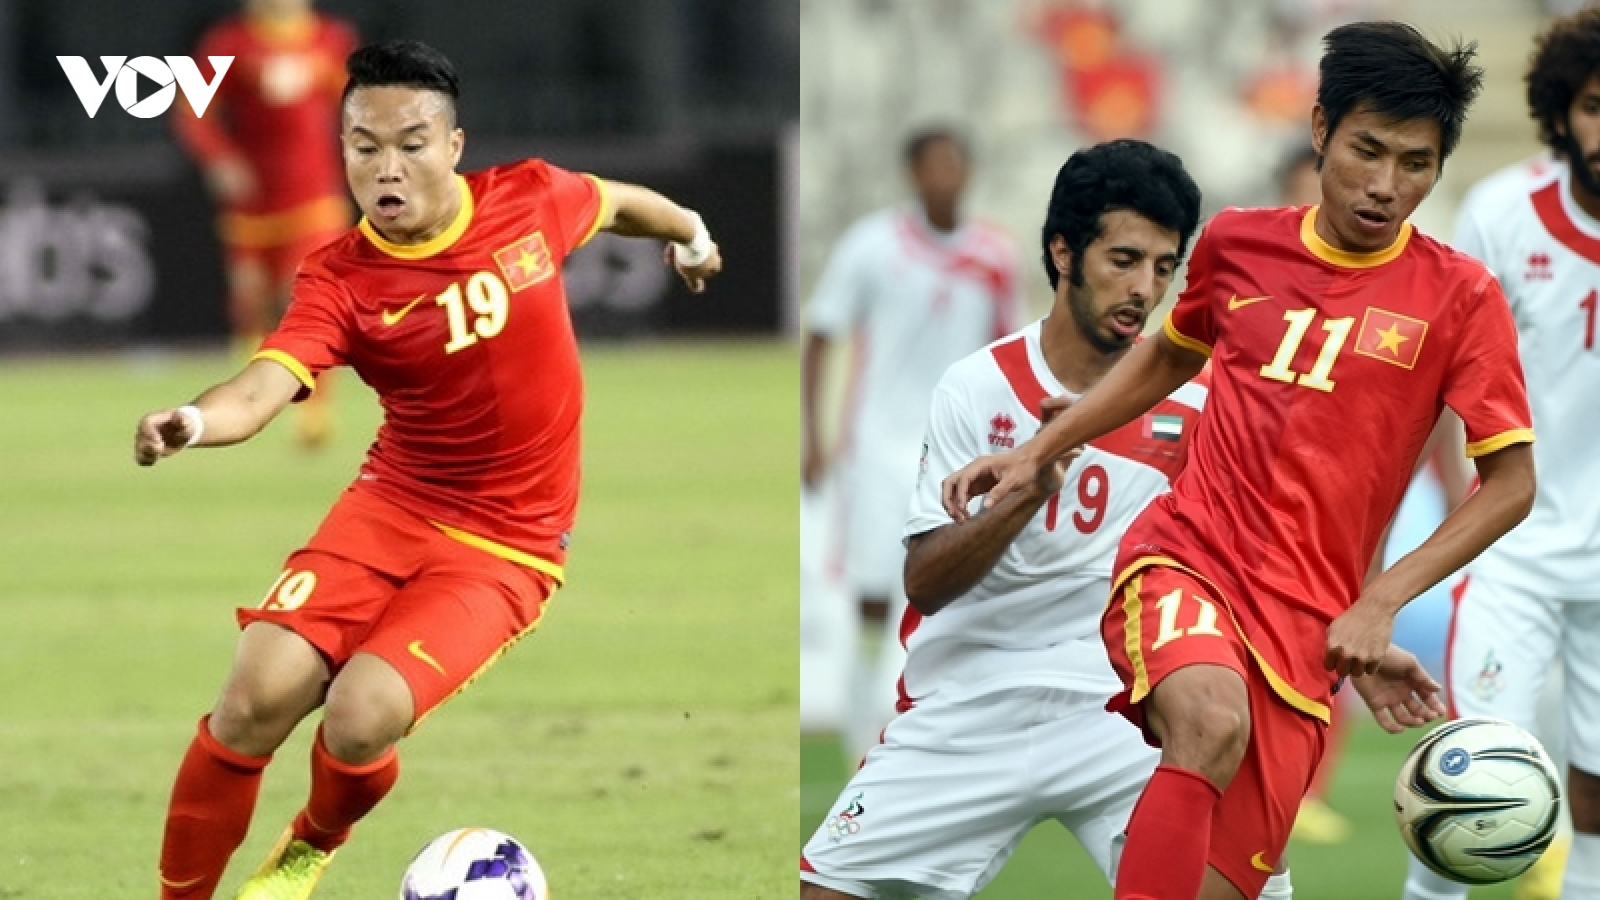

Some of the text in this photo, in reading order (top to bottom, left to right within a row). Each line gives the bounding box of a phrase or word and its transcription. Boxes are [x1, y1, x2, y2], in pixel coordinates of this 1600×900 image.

[434, 270, 509, 354] 19
[1259, 307, 1356, 393] 11
[1151, 587, 1223, 652] 11
